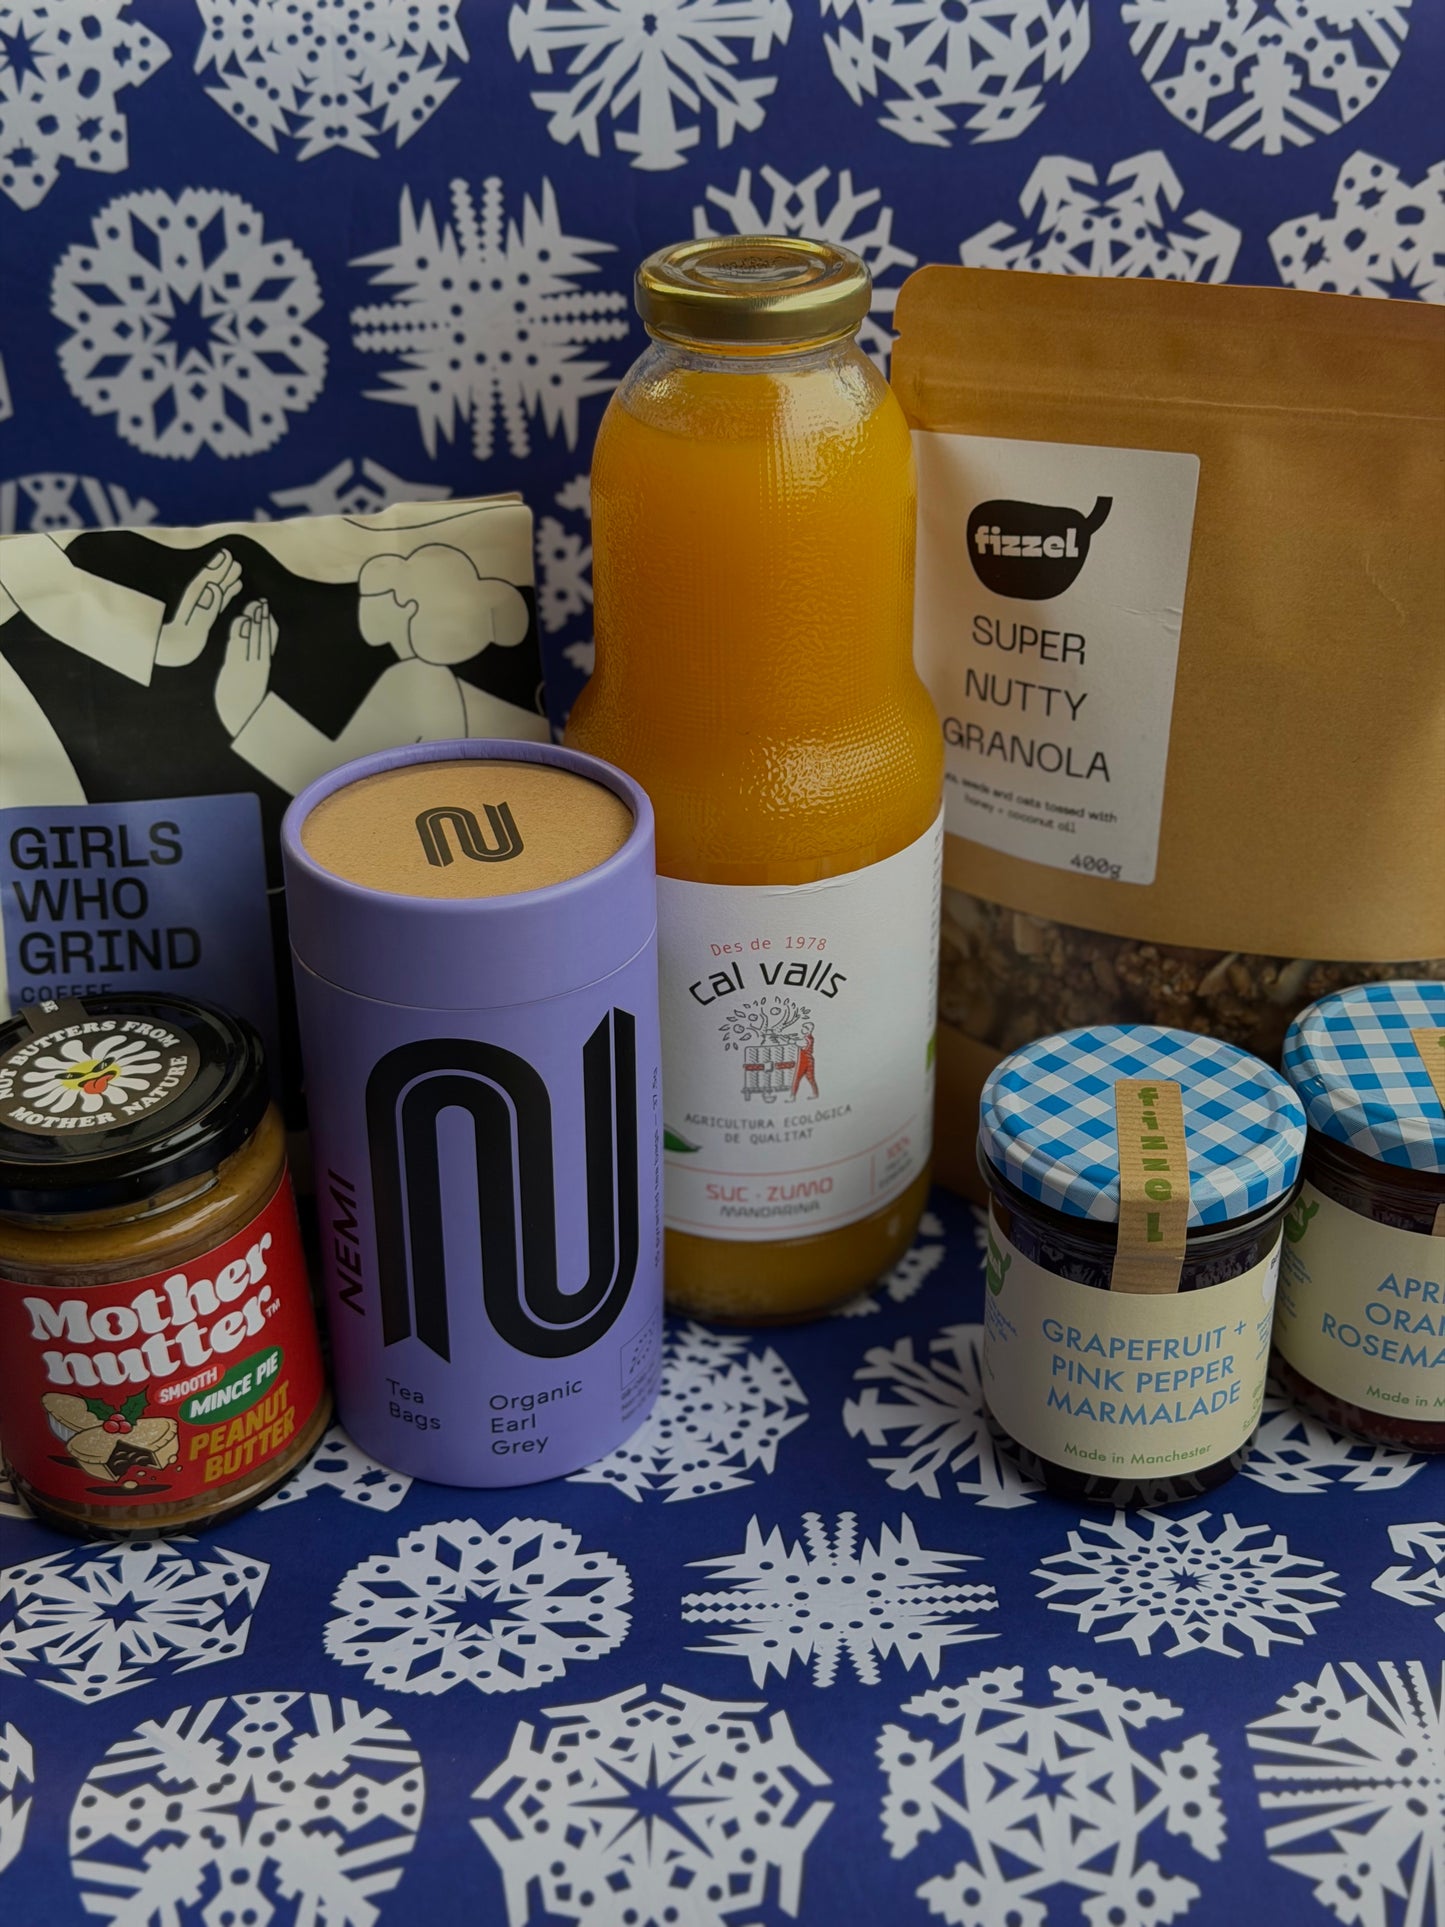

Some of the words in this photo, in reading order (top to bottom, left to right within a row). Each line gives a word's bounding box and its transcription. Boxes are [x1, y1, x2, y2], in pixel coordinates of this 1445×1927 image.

[974, 525, 1079, 558] fizzel
[972, 614, 1086, 665] SUPER
[965, 668, 1088, 721] NUTTY
[943, 716, 1111, 782] GRANOLA
[993, 787, 1014, 802] and
[1016, 793, 1041, 808] oats
[1045, 801, 1085, 819] tossed
[1088, 809, 1117, 824] with
[1007, 810, 1054, 829] coconut
[1058, 820, 1076, 833] oil
[10, 821, 183, 870] GIRLS
[1070, 853, 1122, 880] 400g
[12, 877, 149, 922] WHO
[19, 927, 201, 975] GRIND
[750, 938, 772, 951] de
[785, 936, 828, 951] 1978
[8, 1020, 117, 1066] BUTTERS
[120, 1020, 181, 1049] FROM
[8, 1106, 117, 1129] MOTHER
[121, 1055, 188, 1115] NATURE
[684, 1112, 775, 1130] AGRICULTURA
[724, 1131, 741, 1144] DE
[750, 1128, 814, 1146] QUALITAT
[706, 1184, 748, 1202] SUC
[767, 1177, 834, 1202] ZUMO
[720, 1201, 821, 1219] MANDARINA
[327, 1169, 366, 1316] NEMI
[22, 1232, 272, 1343] Mother
[42, 1285, 272, 1387] nutter
[1365, 1302, 1445, 1337] ORA
[1042, 1318, 1226, 1361] GRAPEFRUIT
[158, 1366, 218, 1404] SMOOTH
[189, 1372, 252, 1418] MINCE
[255, 1350, 279, 1385] PIE
[386, 1378, 424, 1404] Tea
[1052, 1354, 1126, 1393] PINK
[1136, 1355, 1234, 1393] PEPPER
[489, 1379, 583, 1413] Organic
[1047, 1380, 1241, 1426] MARMALADE
[1366, 1385, 1410, 1405] Made
[1415, 1395, 1428, 1407] in
[189, 1380, 290, 1462] PEANUT
[389, 1401, 441, 1430] Bags
[491, 1413, 536, 1434] Earl
[204, 1406, 296, 1484] BUTTER
[491, 1436, 549, 1456] Grey
[1064, 1442, 1107, 1462] Made
[1111, 1451, 1125, 1464] in
[1131, 1443, 1212, 1465] Manchester
